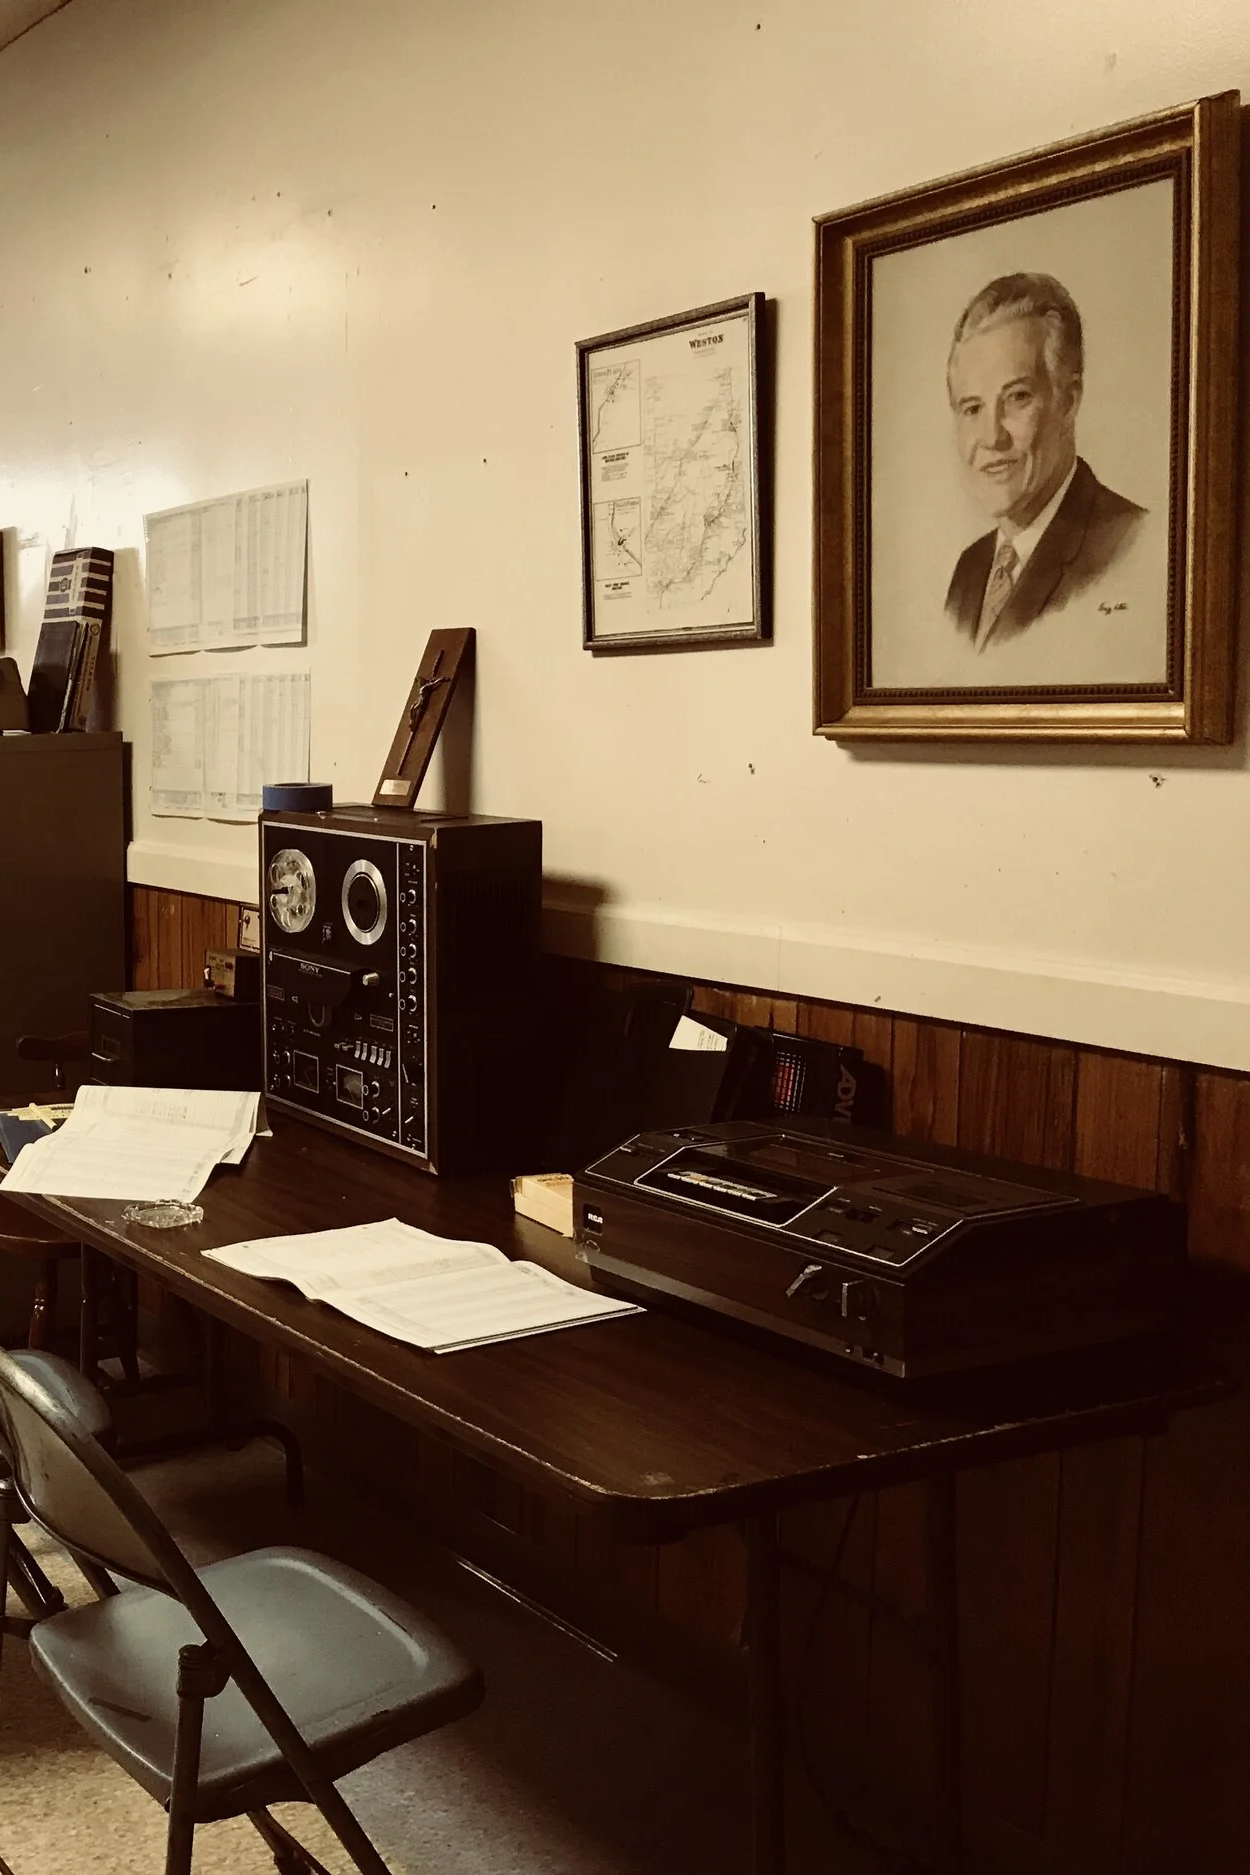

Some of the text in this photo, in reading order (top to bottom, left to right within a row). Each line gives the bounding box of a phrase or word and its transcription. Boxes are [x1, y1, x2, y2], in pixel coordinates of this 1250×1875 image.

[689, 334, 724, 349] WESTON
[300, 963, 320, 973] SONY
[587, 1212, 603, 1224] RCA
